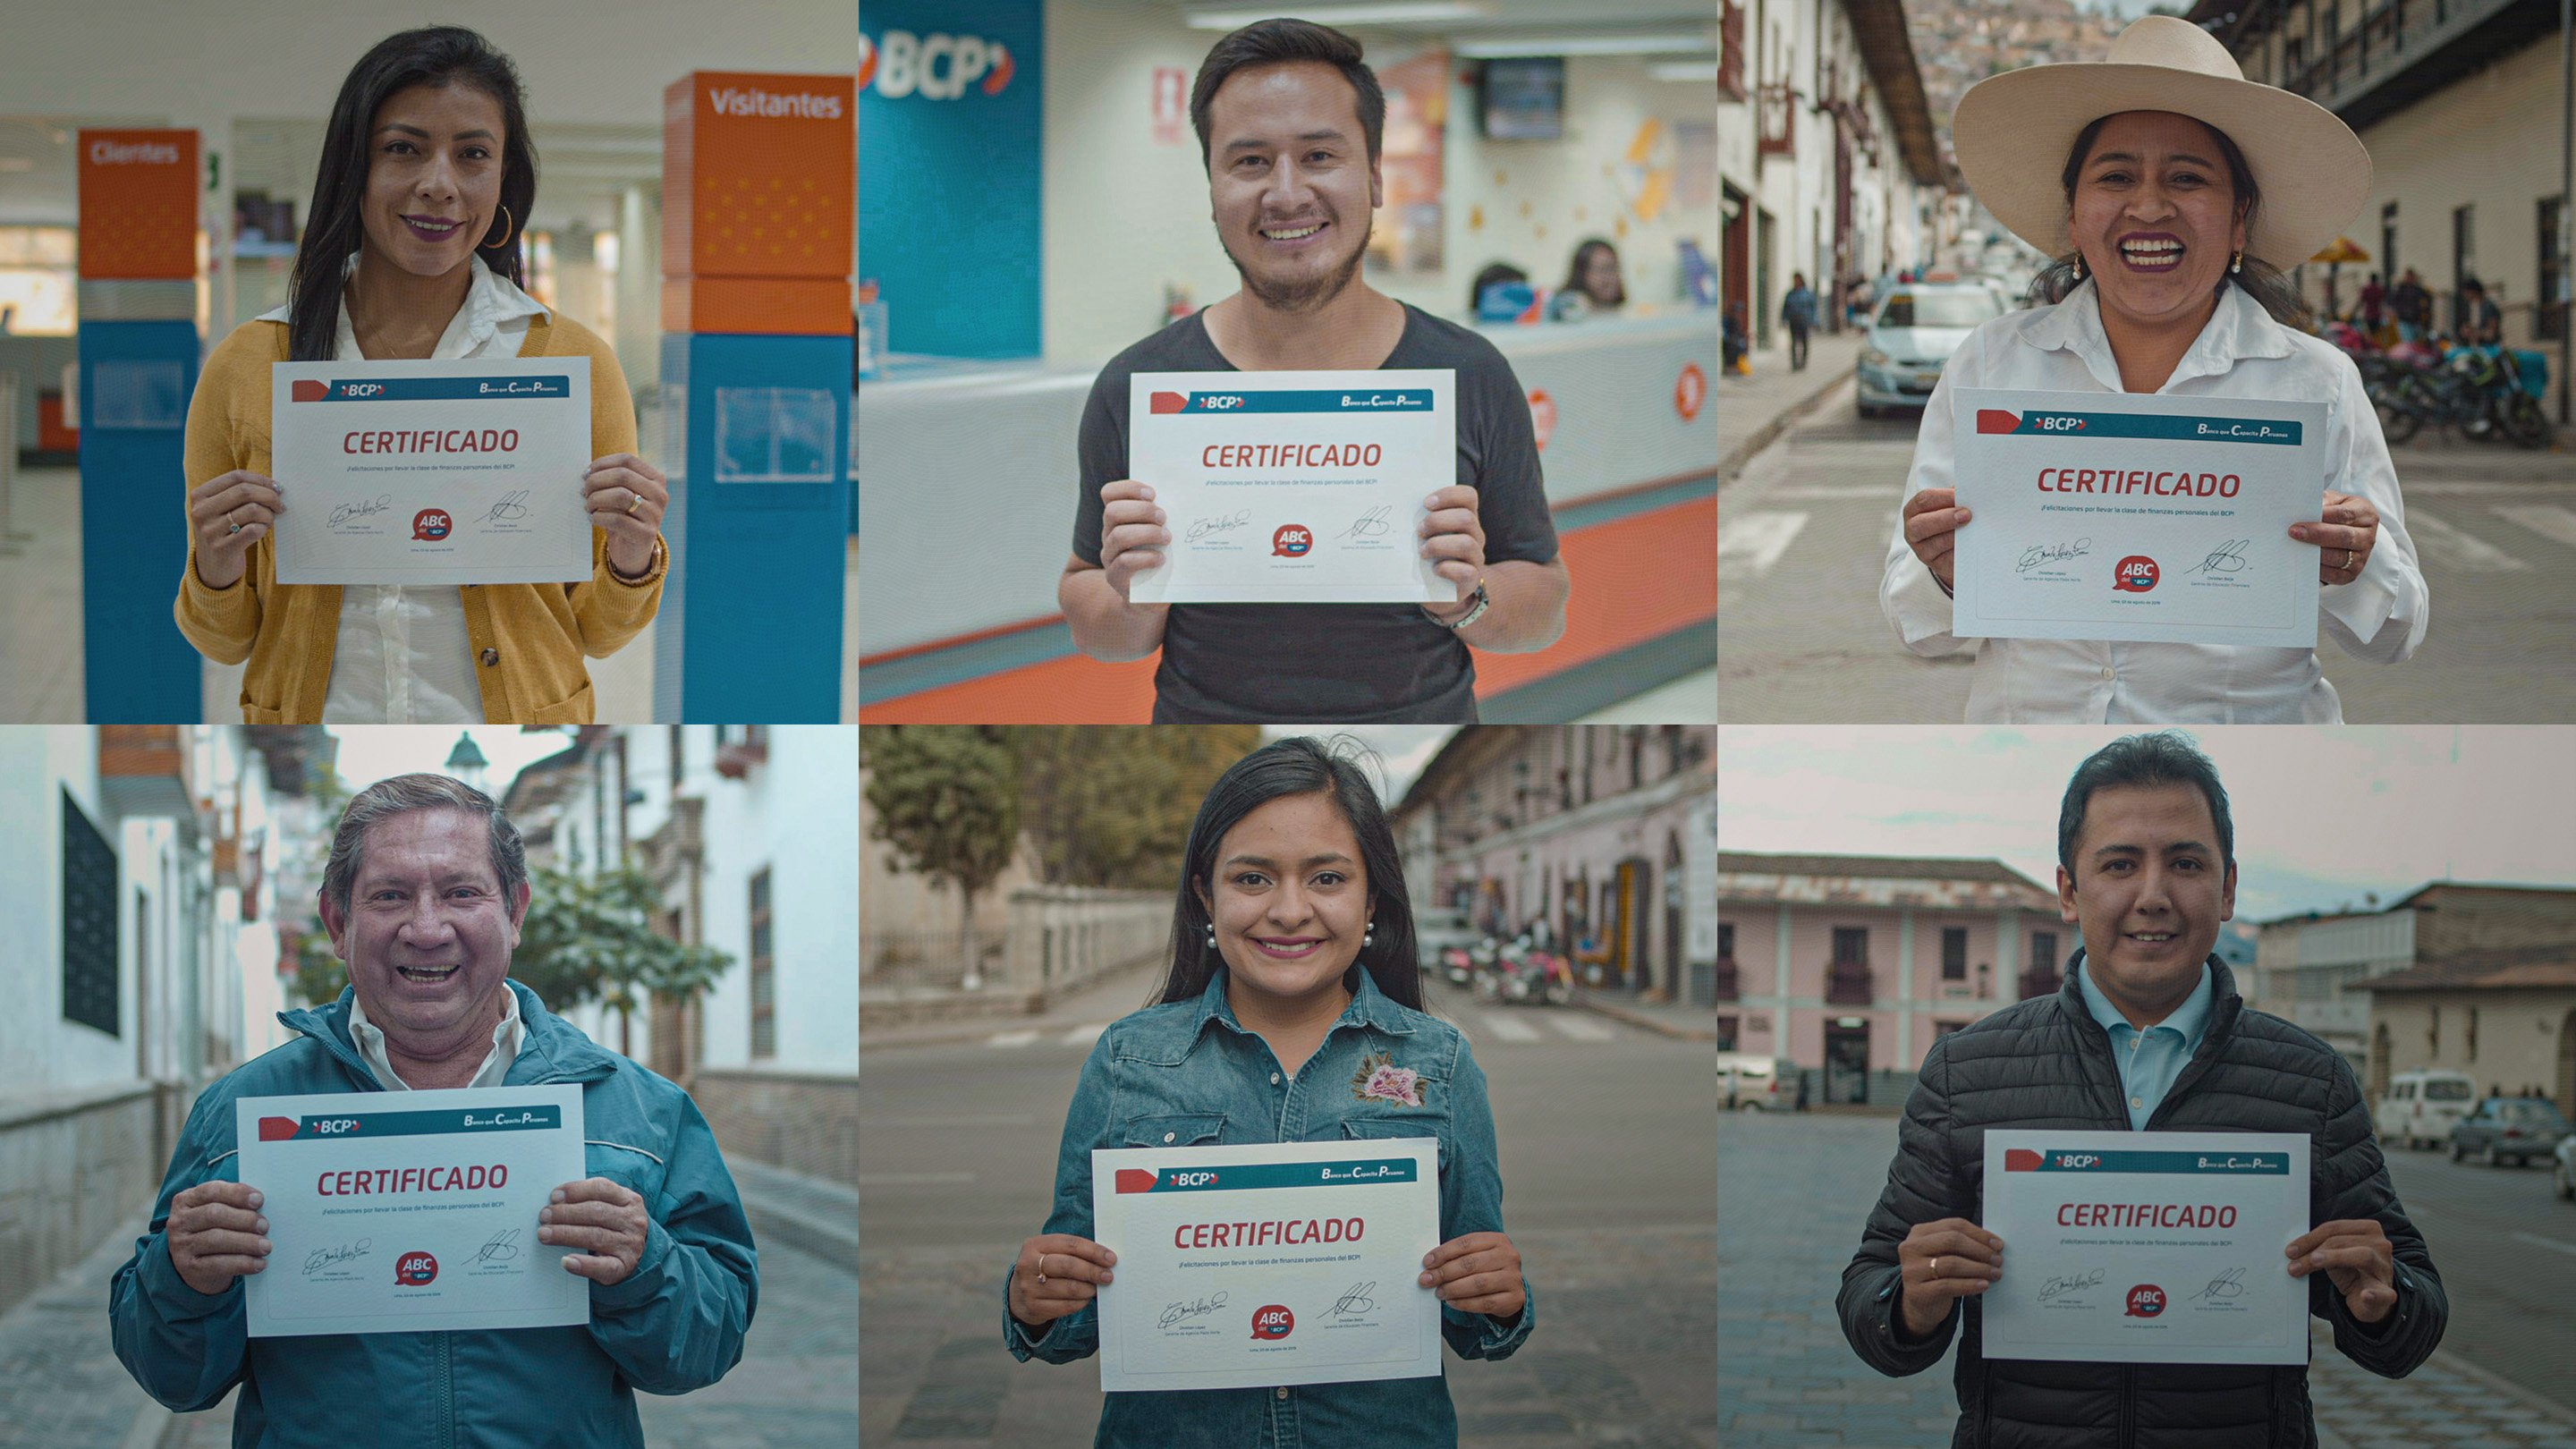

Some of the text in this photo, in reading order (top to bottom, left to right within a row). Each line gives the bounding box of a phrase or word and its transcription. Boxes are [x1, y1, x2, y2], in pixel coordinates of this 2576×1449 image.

[876, 30, 987, 100] BCP
[709, 87, 843, 119] Visitantes
[348, 384, 376, 396] BCP
[1207, 395, 1235, 409] BCP
[2043, 417, 2077, 430] BCP
[343, 429, 519, 453] CERTIFICADO
[1202, 444, 1381, 468] CERTIFICADO
[2038, 467, 2240, 497] CERTIFICADO
[419, 514, 446, 527] ABC
[1278, 530, 1307, 543] ABC
[2122, 563, 2154, 576] ABC
[319, 1119, 351, 1133] BCP
[2063, 1155, 2092, 1167] BCP
[317, 1165, 508, 1196] CERTIFICADO
[1177, 1172, 1209, 1186] BCP
[2057, 1203, 2237, 1228] CERTIFICADO
[1174, 1217, 1364, 1249] CERTIFICADO
[402, 1258, 432, 1271] ABC
[1305, 1255, 1335, 1263] personales
[2132, 1291, 2161, 1303] ABC
[1258, 1310, 1288, 1325] ABC
